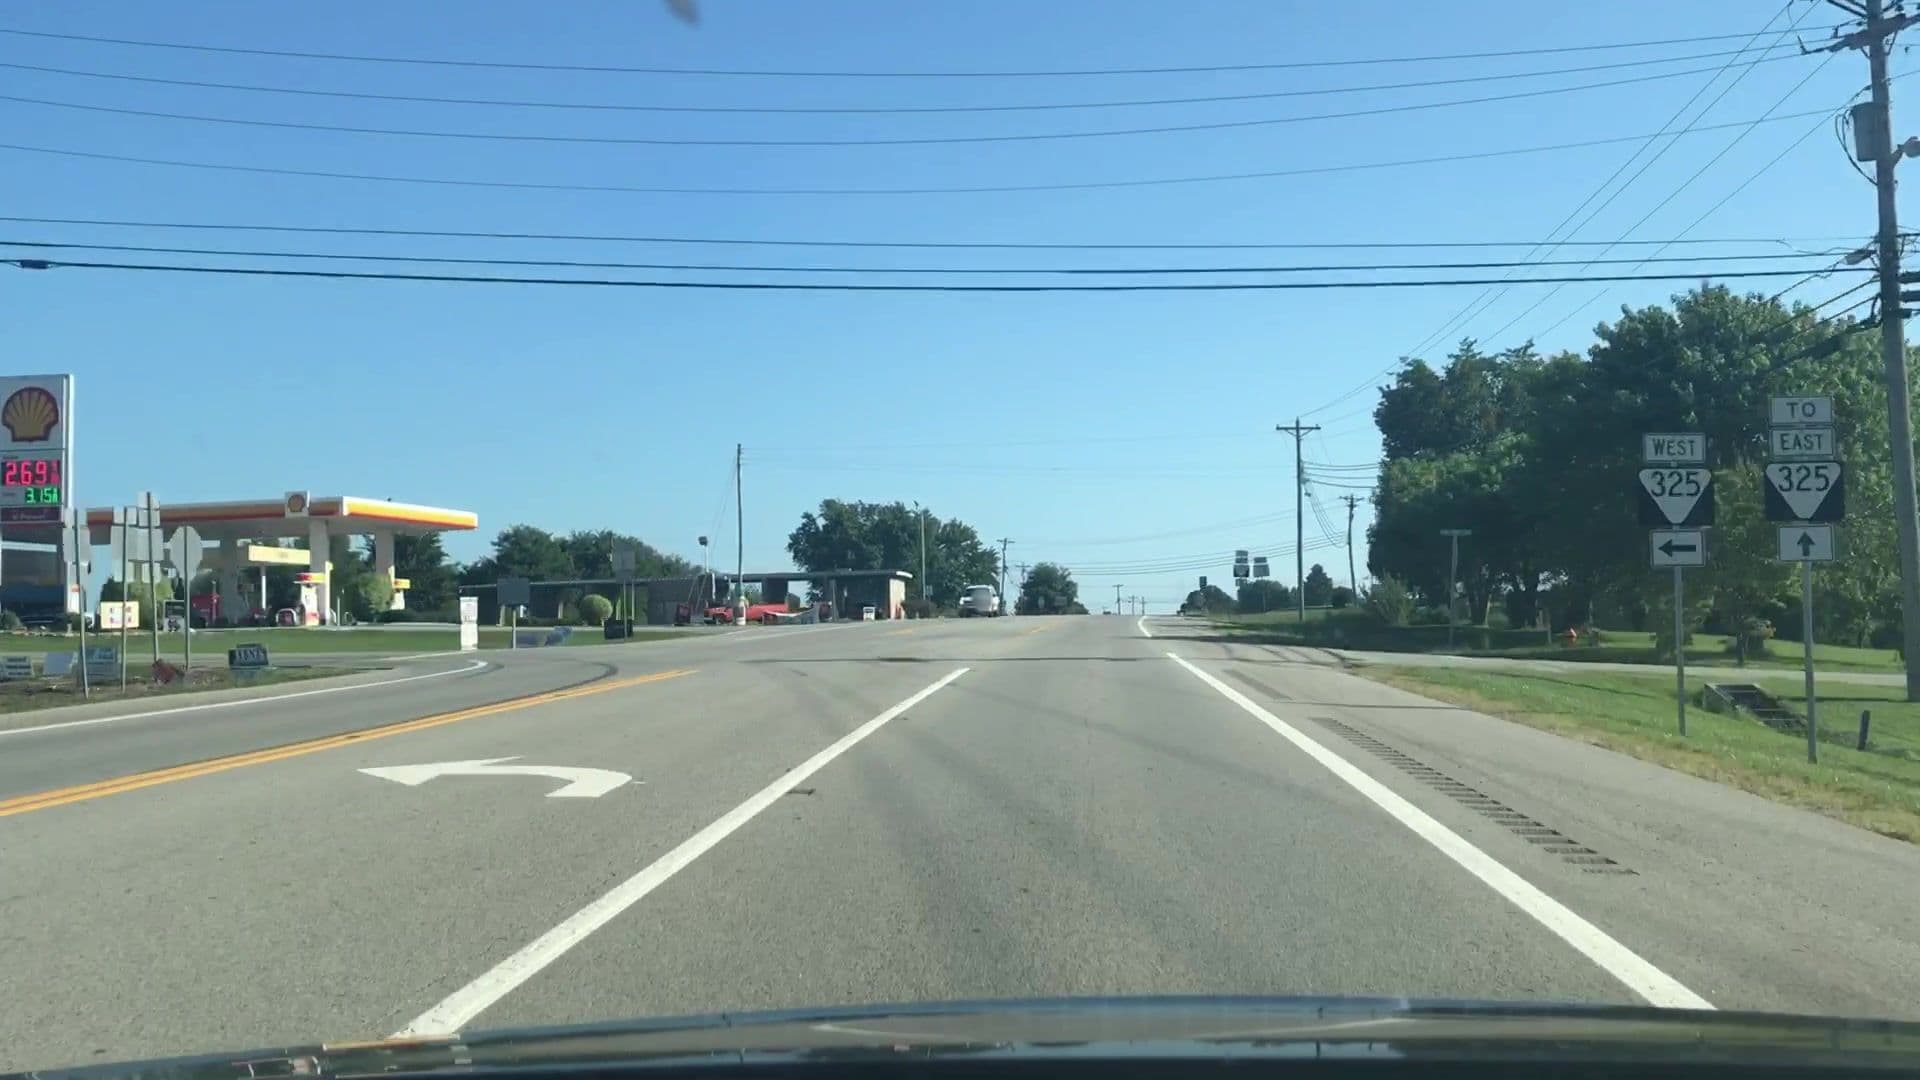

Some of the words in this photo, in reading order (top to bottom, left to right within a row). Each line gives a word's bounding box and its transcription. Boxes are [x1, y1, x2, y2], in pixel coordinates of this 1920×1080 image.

[1786, 402, 1817, 418] TO
[1652, 438, 1696, 457] WEST
[1780, 433, 1825, 451] EAST
[1650, 471, 1702, 498] 325
[1778, 465, 1830, 492] 325
